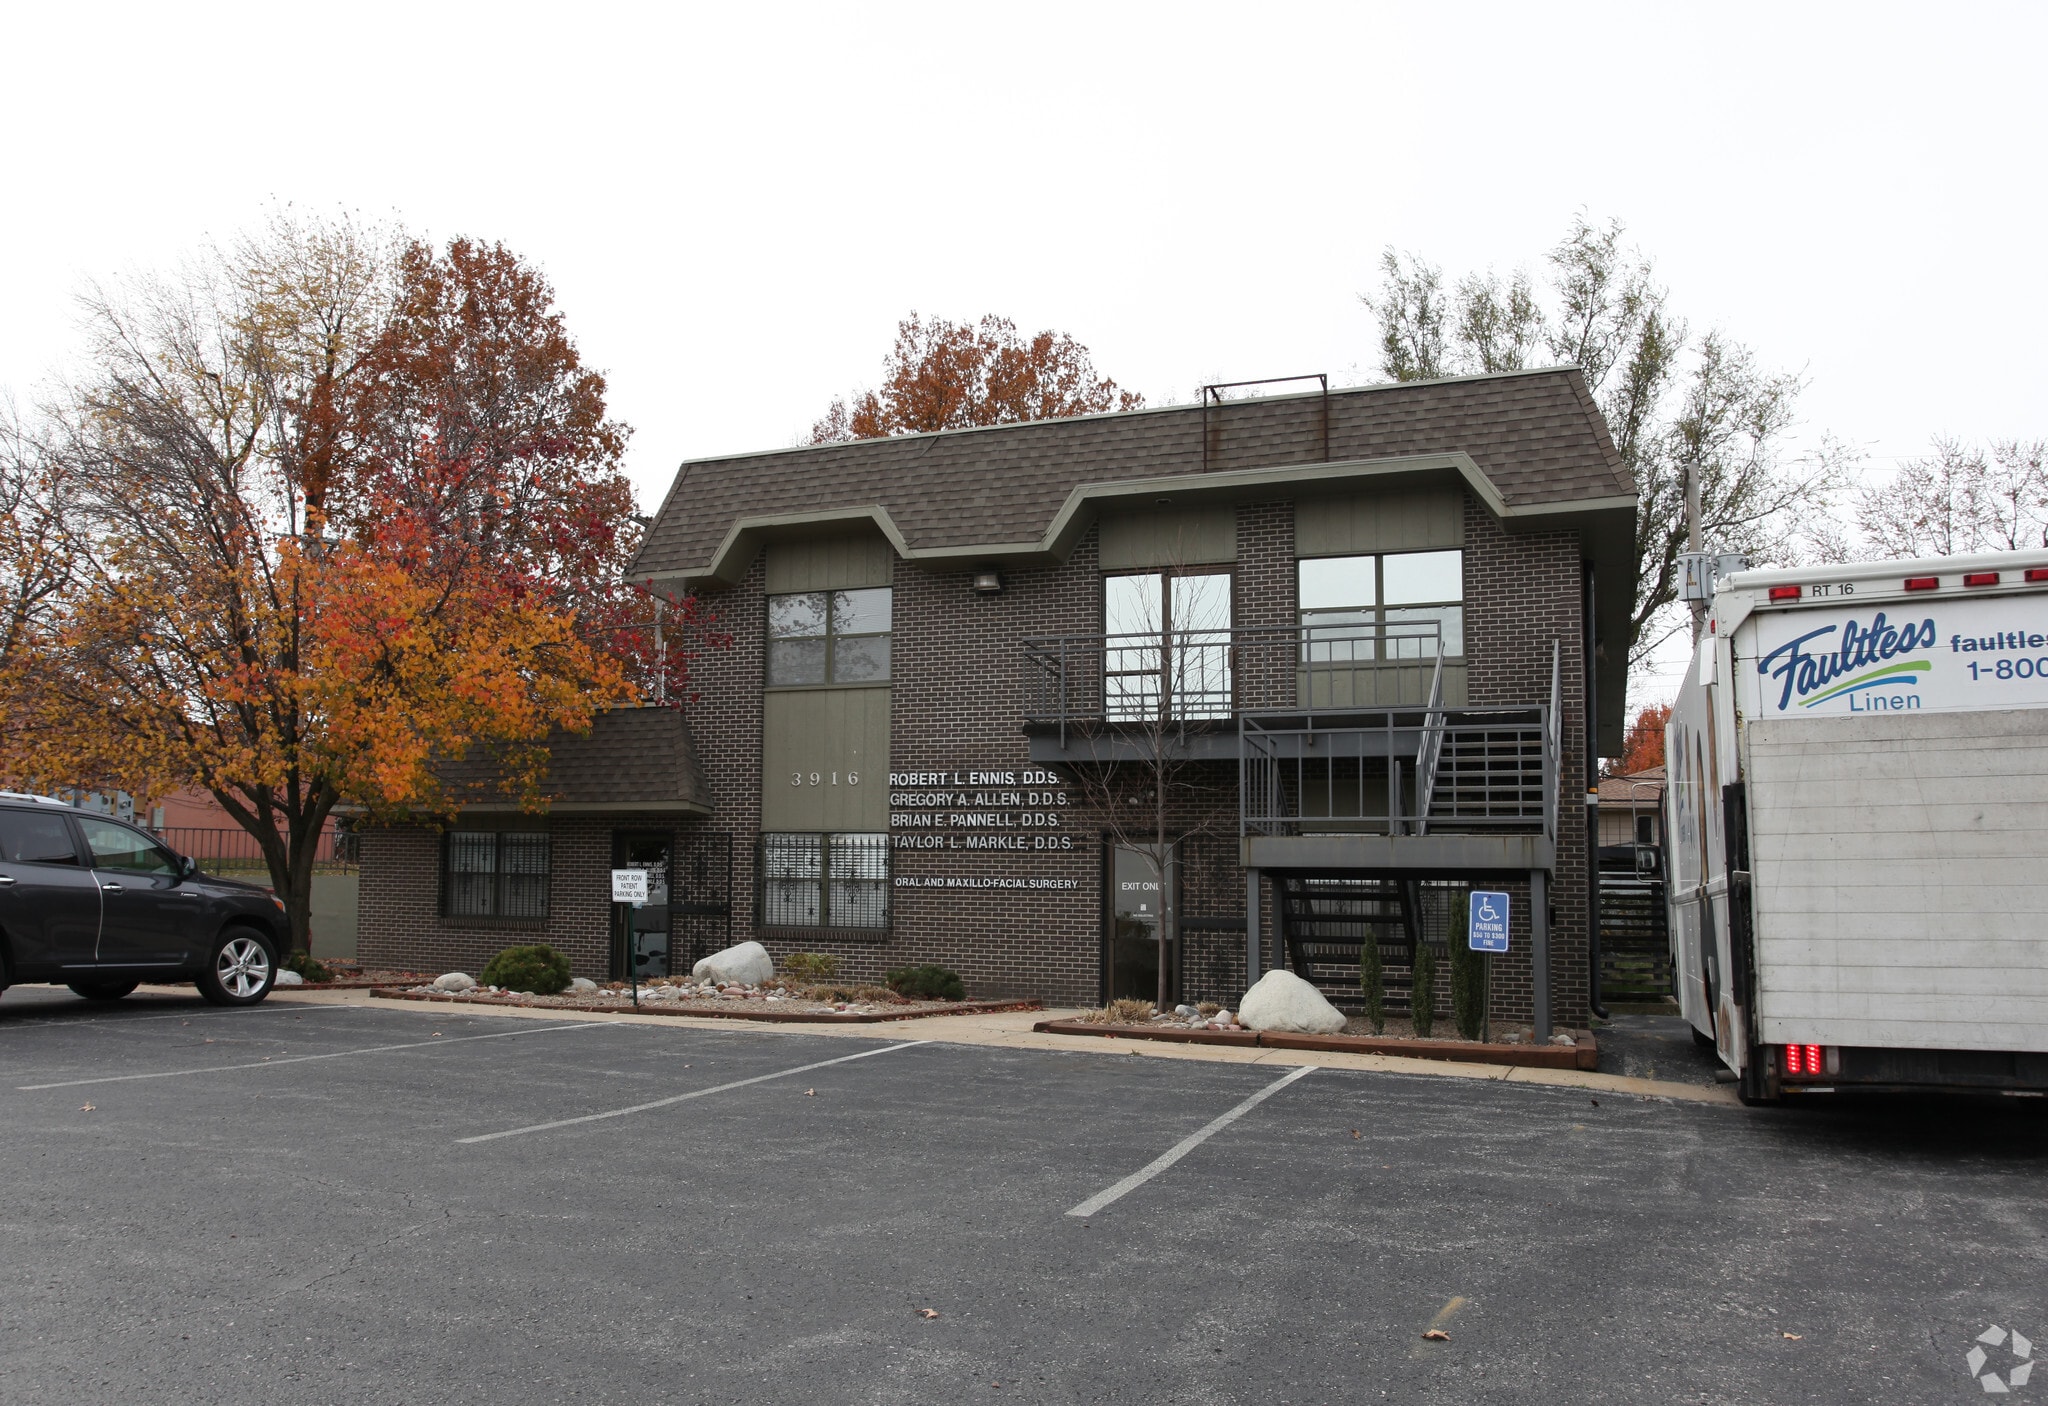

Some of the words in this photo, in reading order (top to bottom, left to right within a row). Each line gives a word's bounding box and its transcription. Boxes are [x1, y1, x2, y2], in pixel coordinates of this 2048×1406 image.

[1812, 585, 1831, 597] RT
[1838, 583, 1854, 595] 16
[1758, 612, 1936, 711] Faultless
[1850, 693, 1921, 712] Linen
[791, 771, 859, 786] 3916
[889, 772, 948, 786] ROBERT
[954, 772, 966, 785] L.
[969, 771, 1017, 786] ENNIS,
[1023, 771, 1060, 785] D.D.S.
[890, 793, 954, 807] GREGORY
[957, 793, 970, 806] A.
[974, 792, 1025, 807] ALLEN,
[1029, 792, 1071, 806] D.D.S.
[891, 814, 931, 827] BRIAN
[935, 814, 947, 827] E.
[950, 813, 1017, 828] PANNELL,
[1022, 813, 1060, 827] D.D.S.
[892, 835, 944, 848] TAYLOR
[950, 836, 962, 849] L.
[966, 836, 1029, 851] MARKLE,
[1035, 836, 1074, 850] D.D.S.
[895, 877, 921, 887] ORAL
[923, 878, 944, 887] AND
[947, 878, 1027, 889] MAXILLO-FACIAL
[1028, 879, 1079, 889] SURGERY
[1121, 882, 1141, 891] EXIT
[1142, 882, 1166, 891] ONL
[1475, 922, 1503, 931] PARKING
